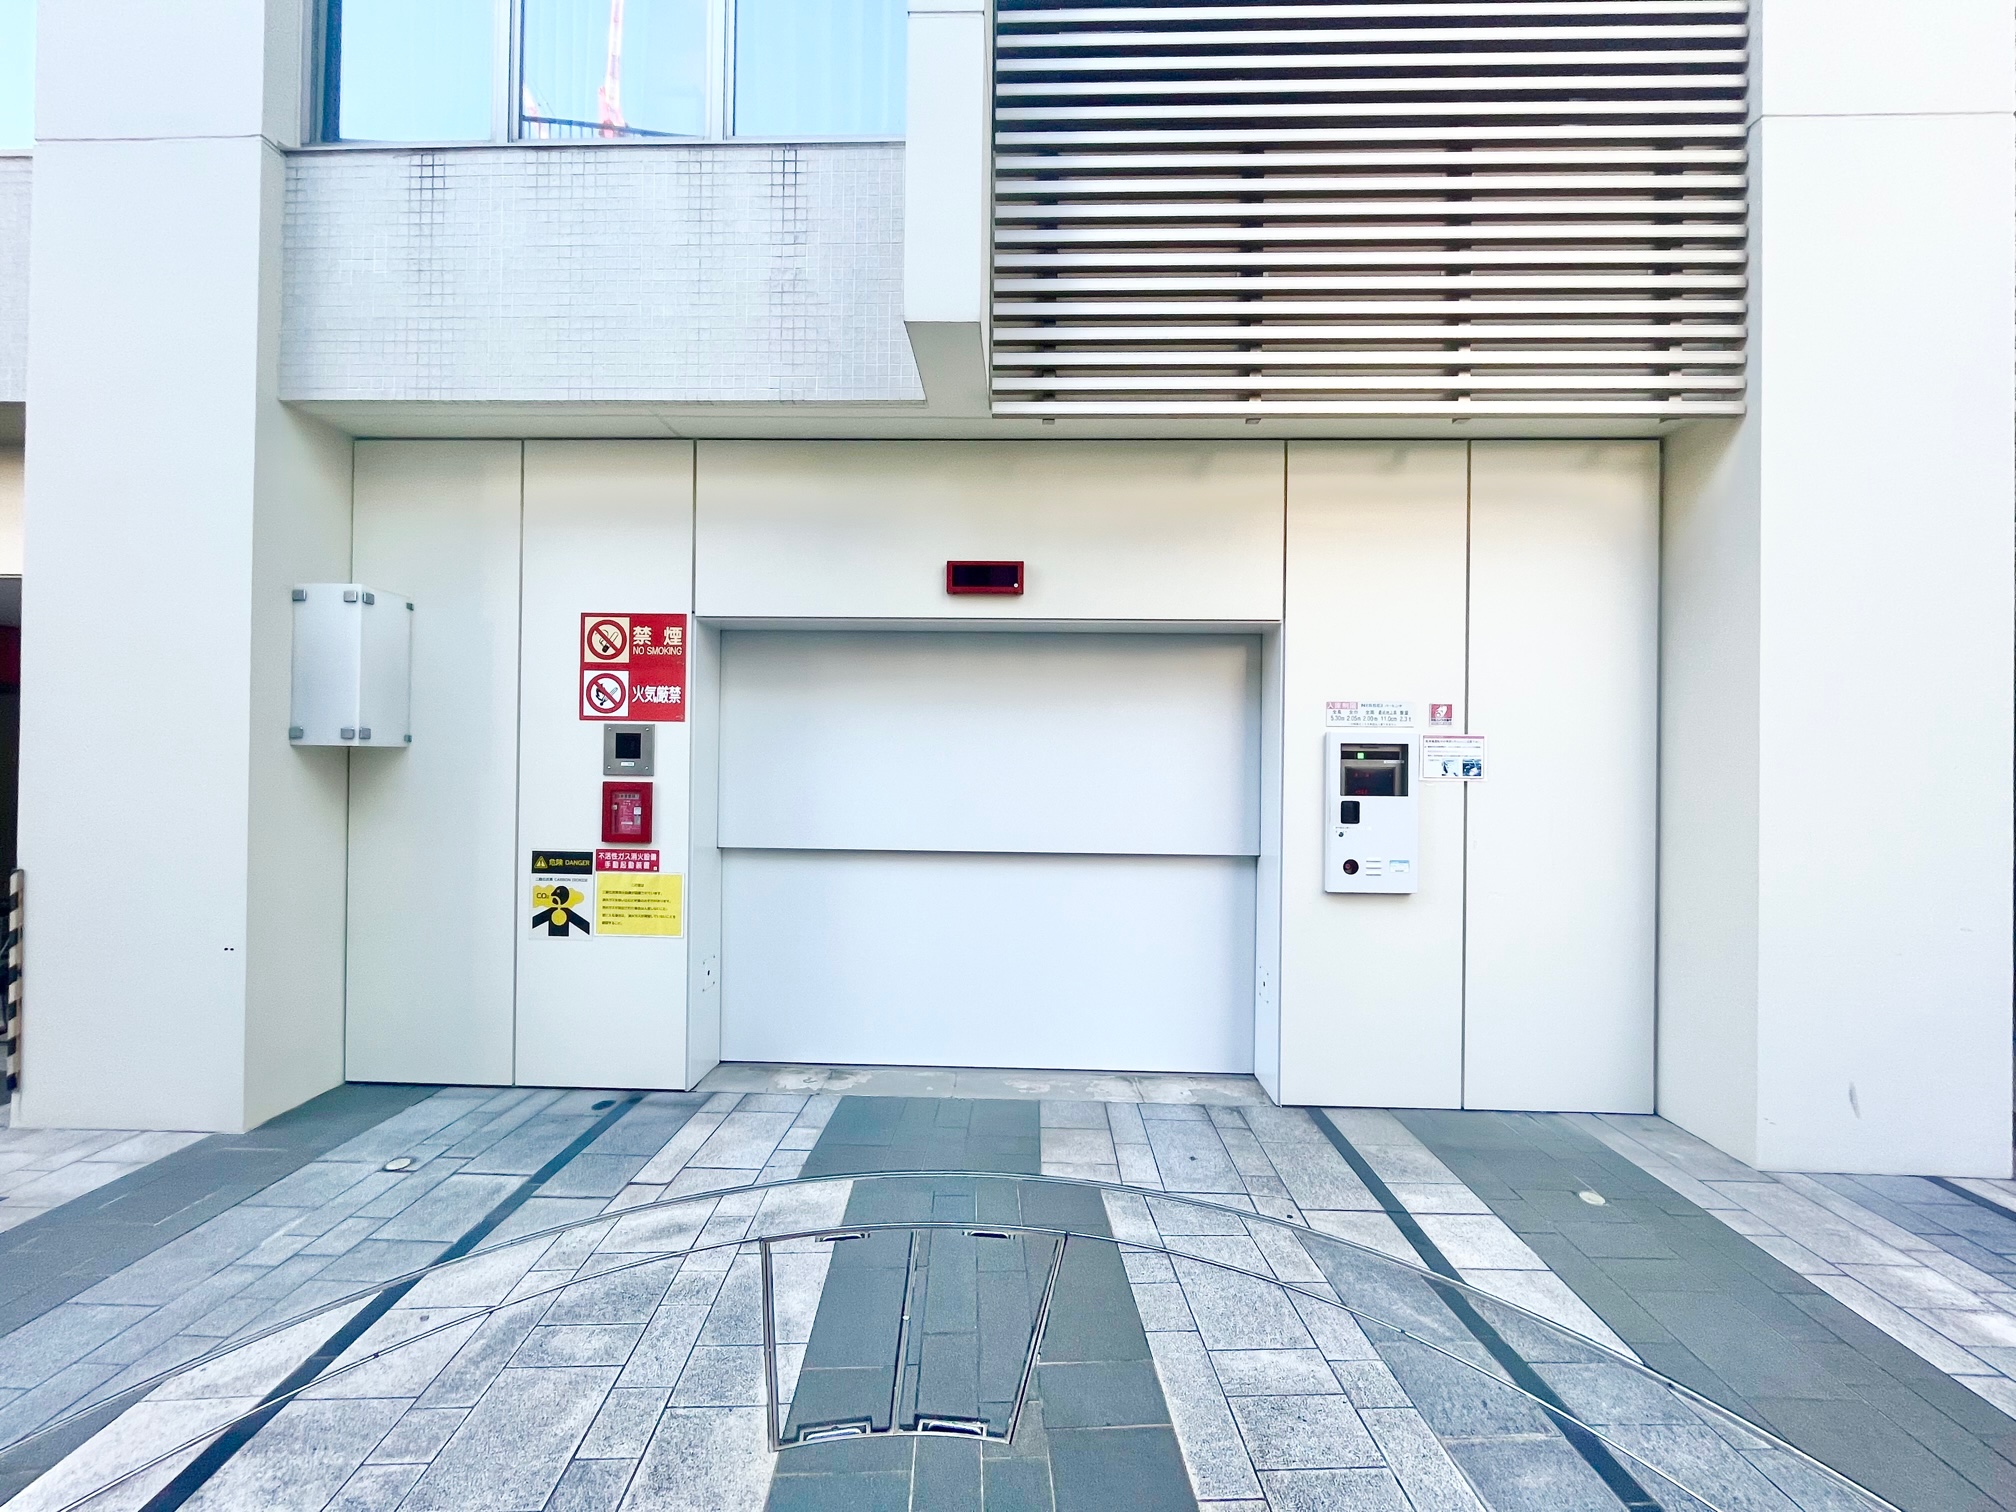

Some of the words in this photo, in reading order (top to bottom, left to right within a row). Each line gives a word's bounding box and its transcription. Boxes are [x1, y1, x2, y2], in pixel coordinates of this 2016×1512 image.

[632, 646, 645, 655] NO
[646, 647, 683, 655] SMOKING
[632, 685, 681, 704] 火気厳禁
